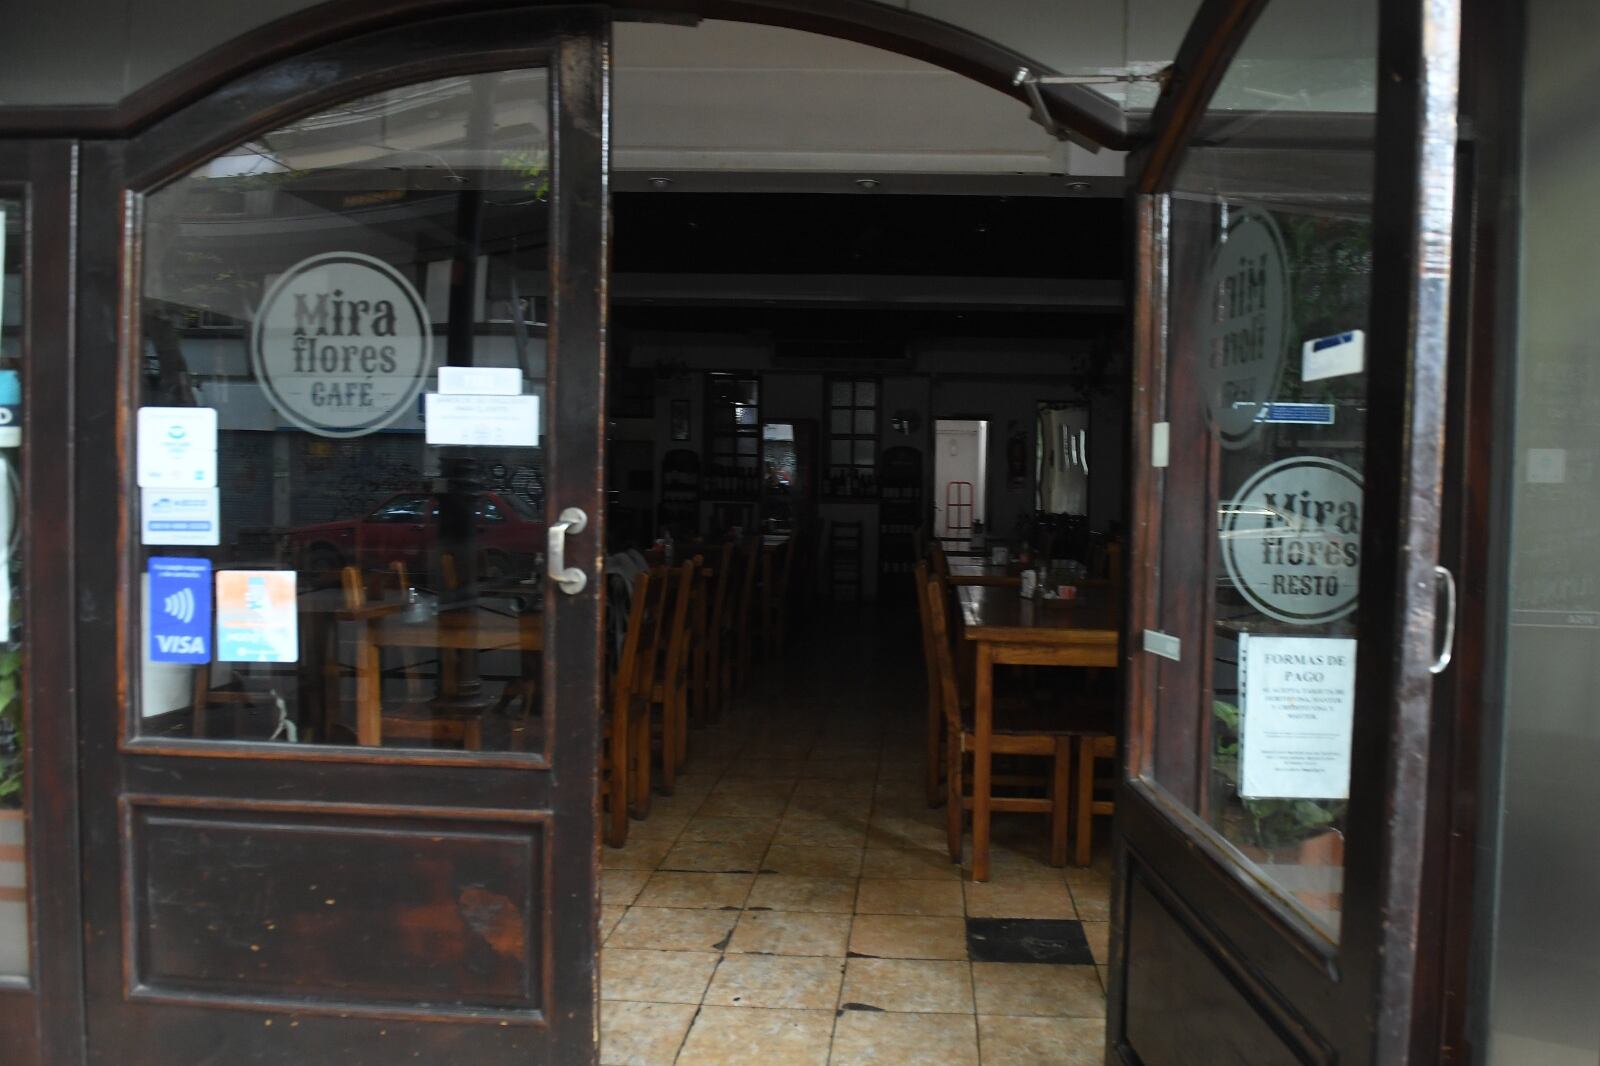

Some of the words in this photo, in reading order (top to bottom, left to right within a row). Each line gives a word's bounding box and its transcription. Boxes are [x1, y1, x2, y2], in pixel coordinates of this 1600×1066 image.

[293, 289, 396, 336] Mira
[292, 337, 397, 373] flores
[1264, 490, 1360, 535] Mira
[1261, 537, 1358, 567] flores
[154, 635, 206, 654] VISA
[1264, 653, 1325, 665] FORMAS
[1327, 655, 1346, 666] DE
[1284, 671, 1325, 682] PAGO
